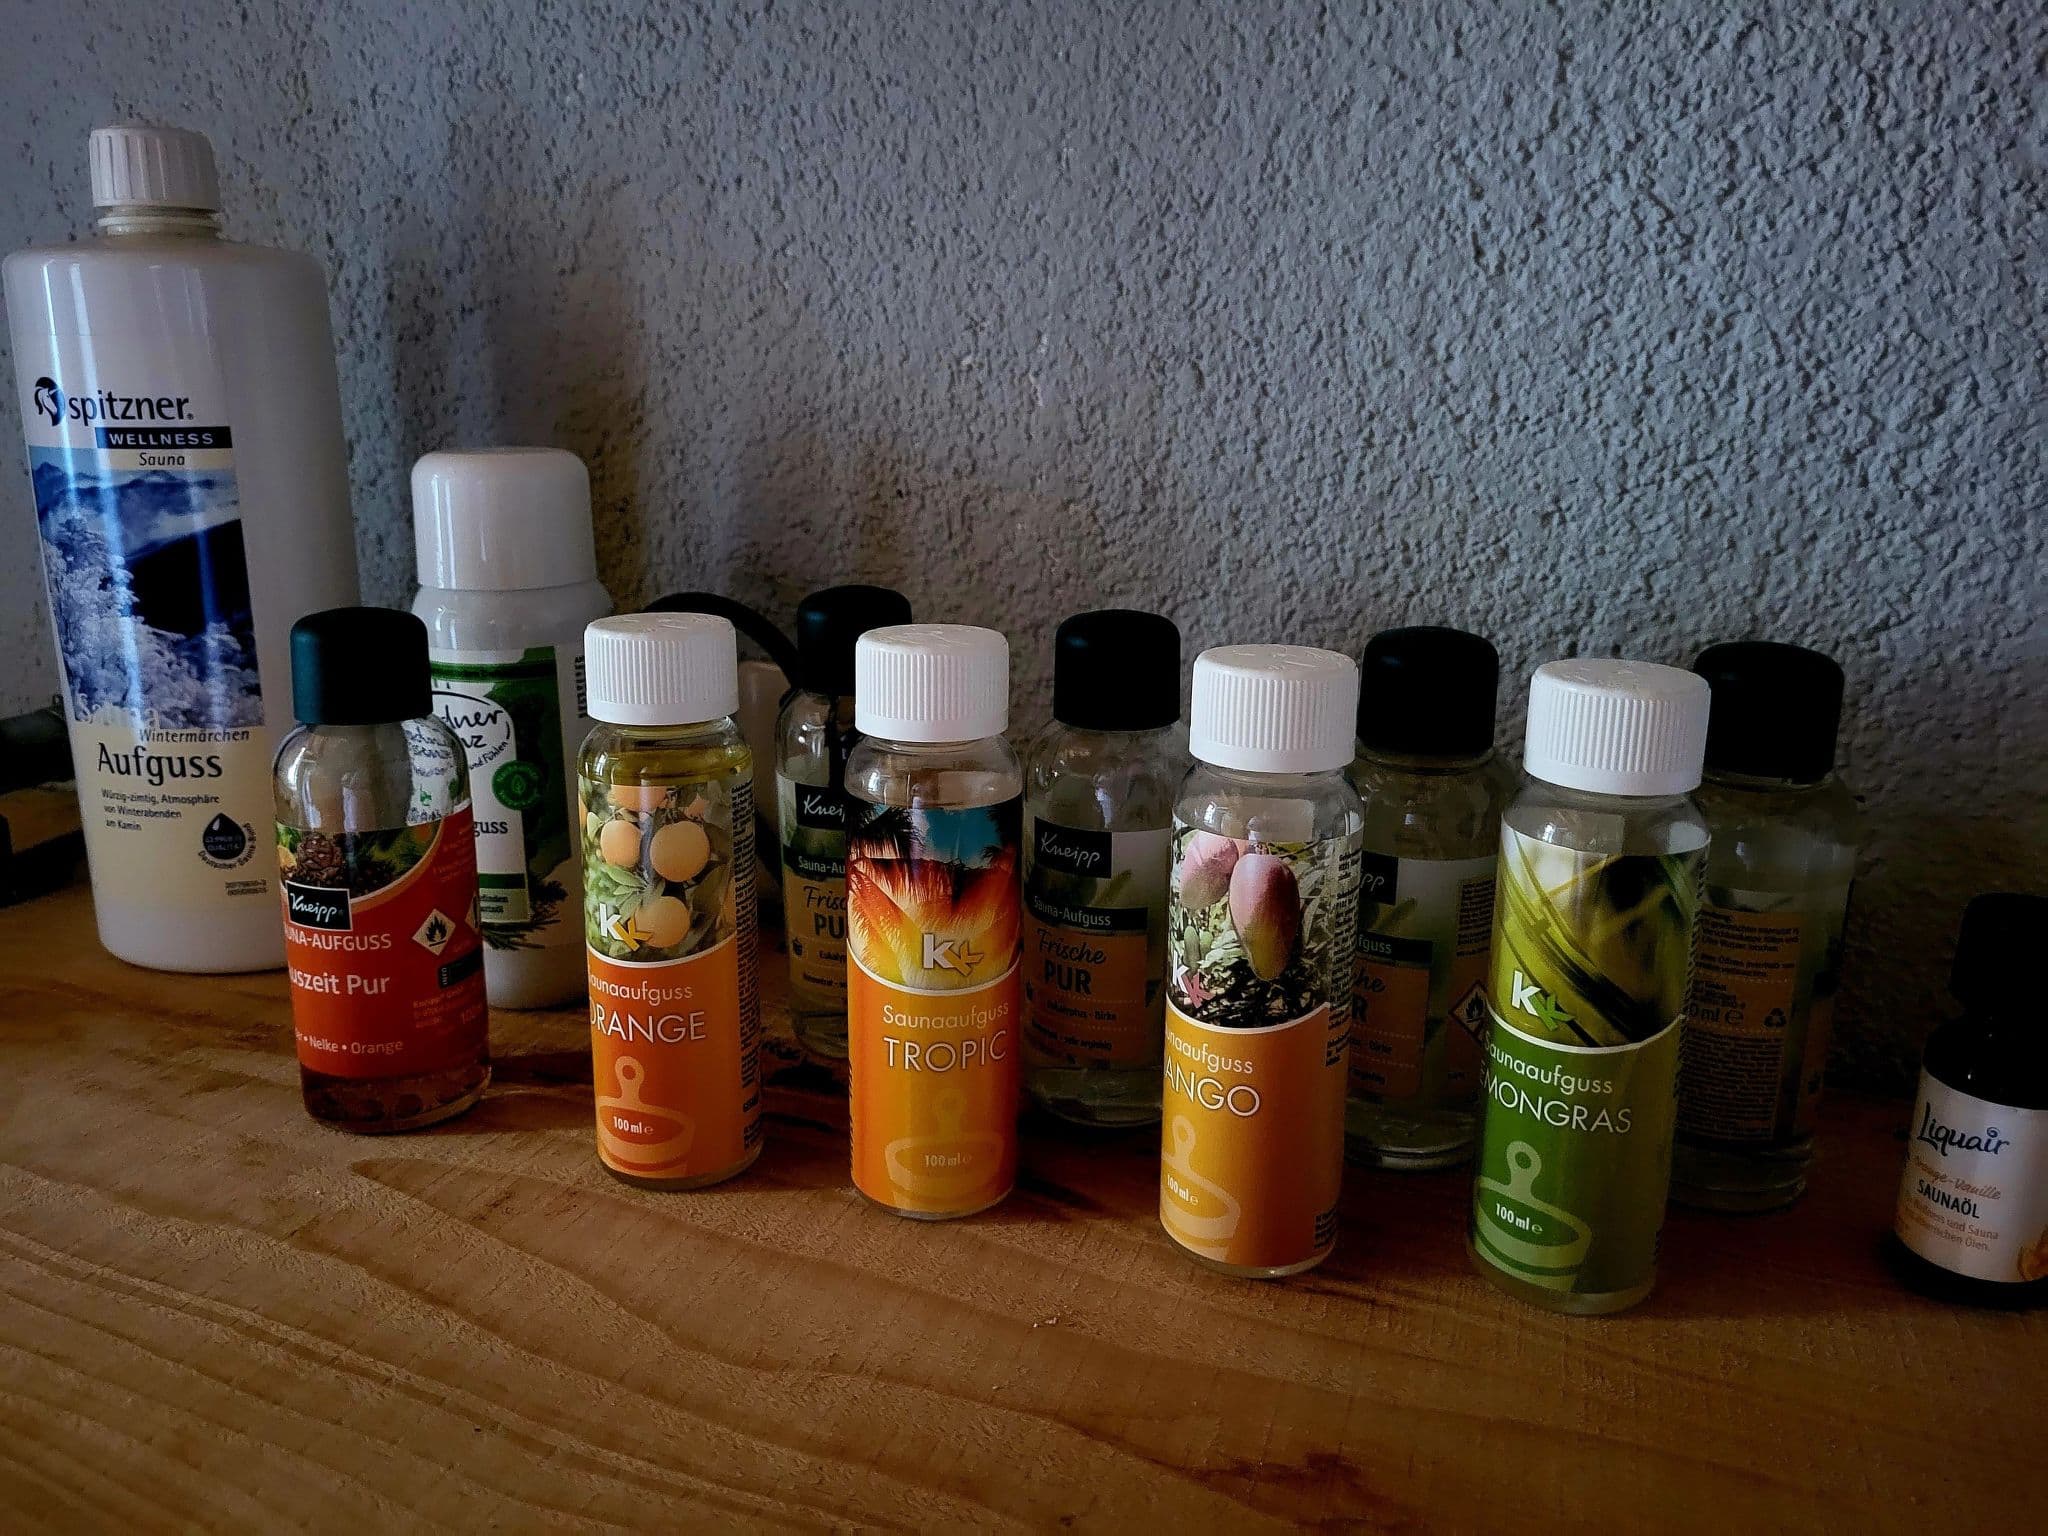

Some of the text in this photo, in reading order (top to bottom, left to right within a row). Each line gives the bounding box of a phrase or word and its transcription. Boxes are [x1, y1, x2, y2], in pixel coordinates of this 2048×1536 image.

[109, 432, 214, 446] WELLNESS
[139, 452, 185, 466] Sauna
[98, 742, 222, 786] Aufguss
[1040, 831, 1101, 870] Kneipp
[289, 892, 338, 923] Kneipp
[1032, 896, 1112, 928] Sauna-Aufguss
[1037, 928, 1107, 966] Frische
[347, 974, 391, 995] Pur
[1044, 959, 1092, 996] PUR
[883, 1002, 1009, 1029] Saunaaufguss
[309, 1034, 404, 1055] Nelke Orange
[883, 1030, 1009, 1072] TROPIC
[1917, 1102, 2010, 1156] Liquair
[1917, 1178, 1980, 1219] SAUNAÖL
